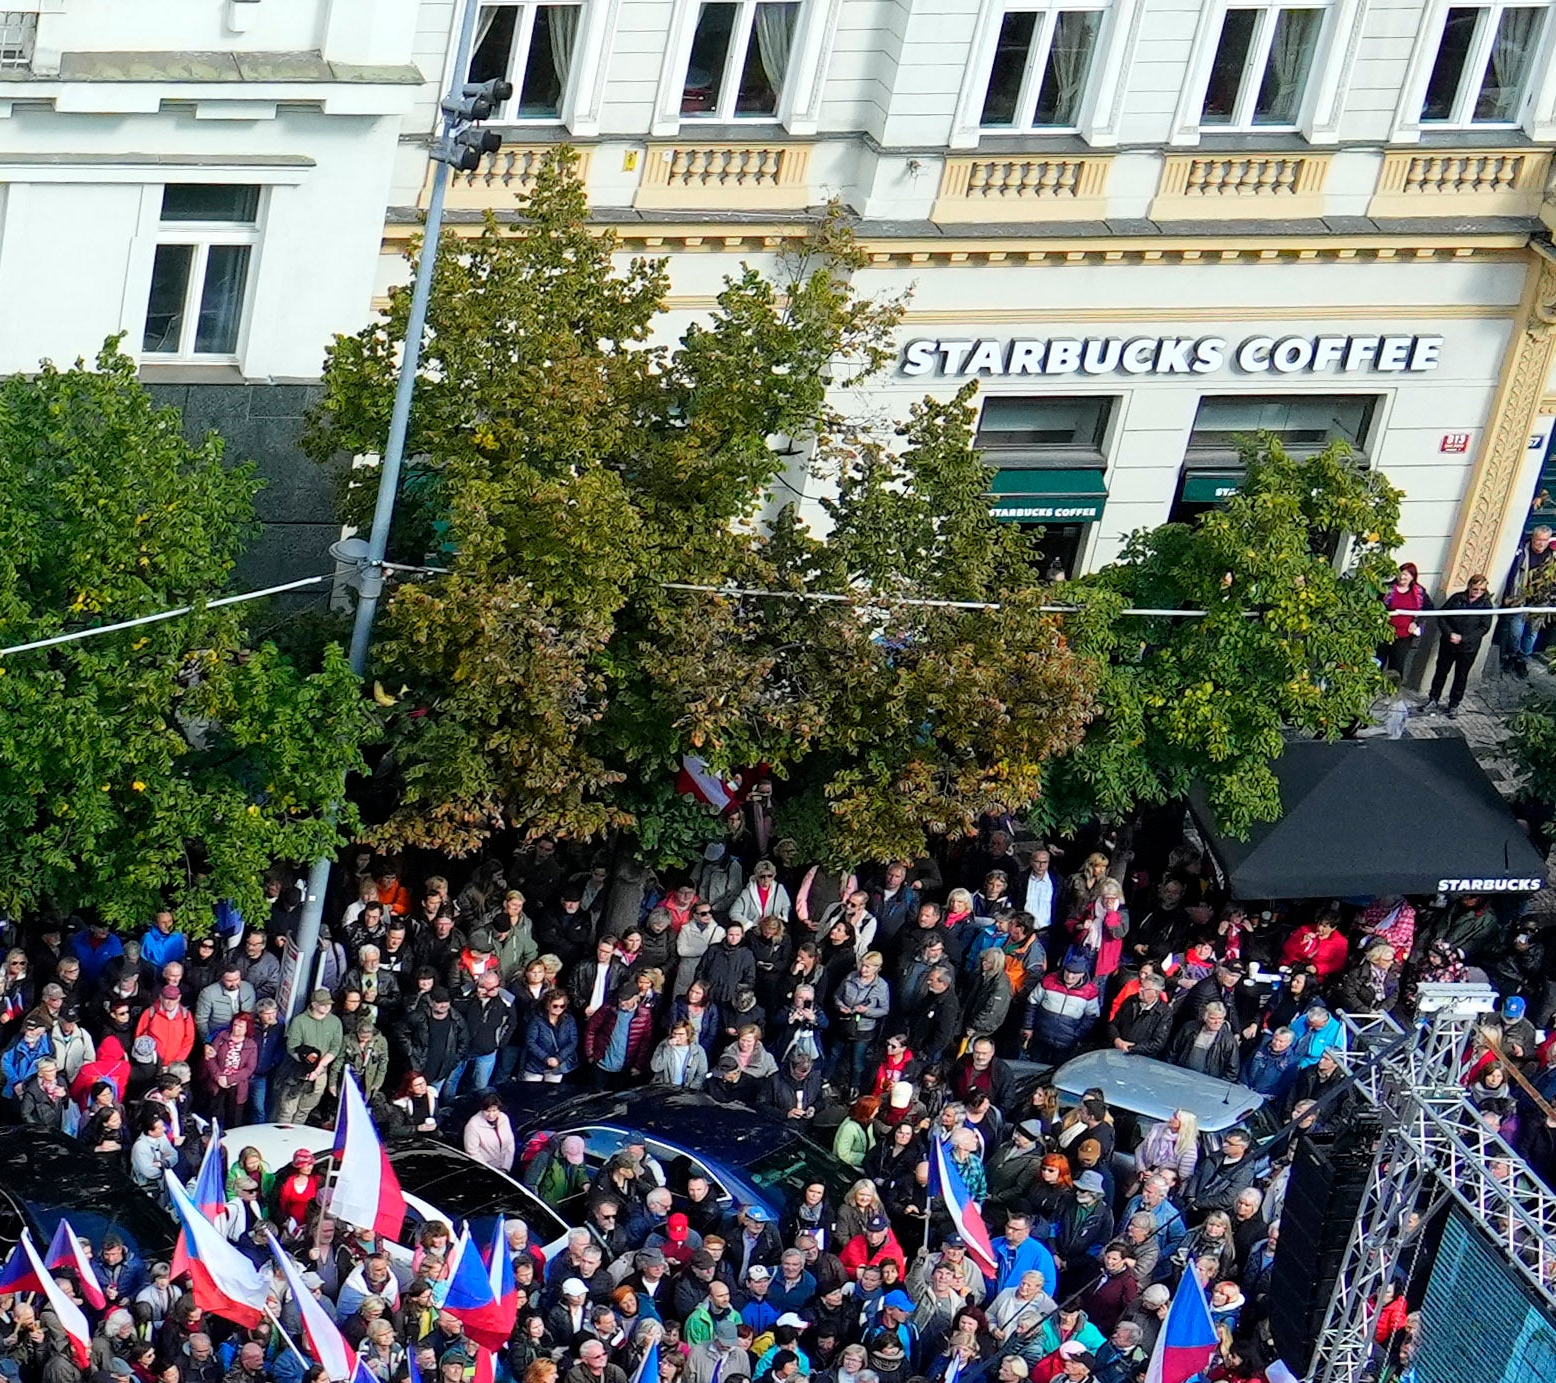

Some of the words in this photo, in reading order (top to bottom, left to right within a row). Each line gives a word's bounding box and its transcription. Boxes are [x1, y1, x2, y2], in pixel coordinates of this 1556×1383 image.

[901, 338, 1227, 377] STARBUCKS
[1238, 335, 1444, 375] COFFEE
[989, 507, 1053, 518] STARBUCKS
[1054, 507, 1097, 517] COFFEE
[1438, 878, 1542, 892] STARBUCKS
